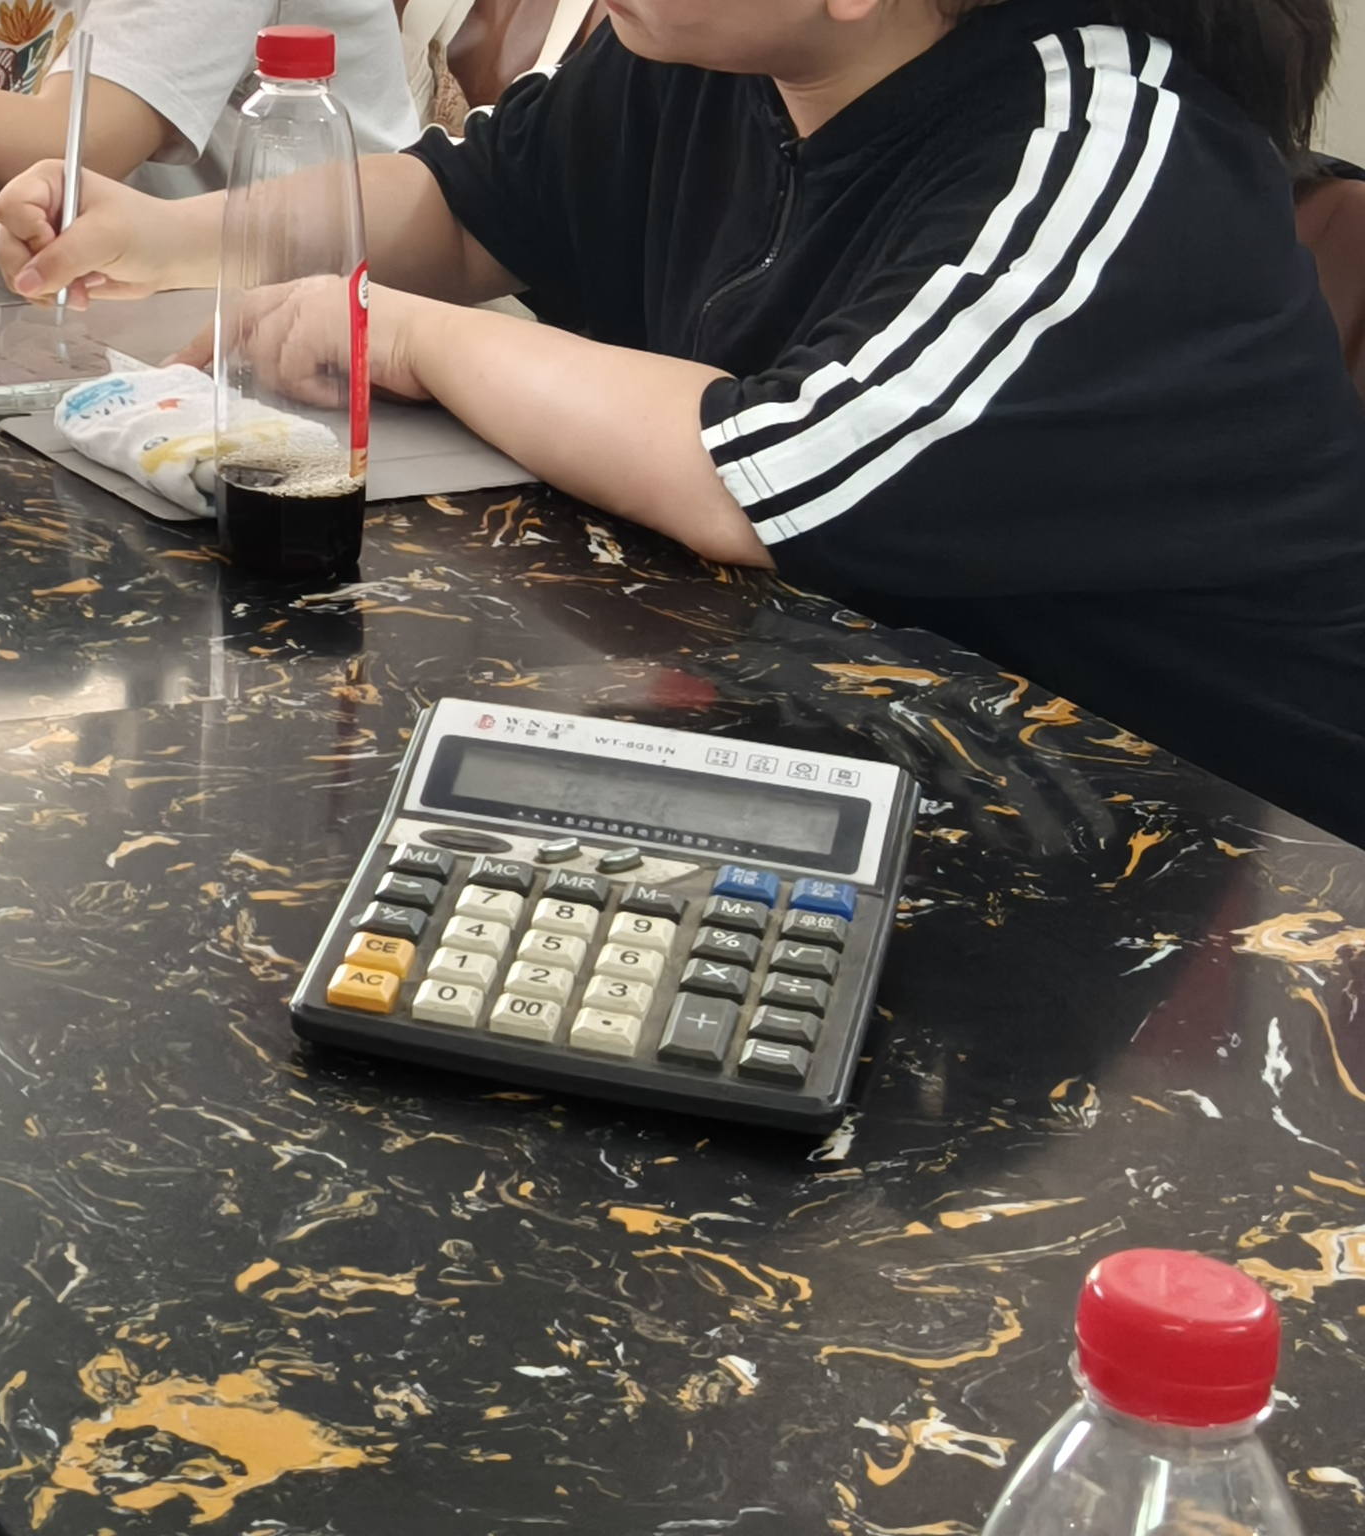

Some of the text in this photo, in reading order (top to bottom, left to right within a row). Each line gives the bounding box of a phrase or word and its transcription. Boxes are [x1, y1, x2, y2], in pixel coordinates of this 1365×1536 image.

[403, 848, 440, 864] MU
[483, 860, 519, 876] MC
[558, 873, 596, 889] MR
[480, 890, 501, 904] 7
[555, 905, 575, 919] 8
[465, 923, 488, 937] 4
[632, 919, 652, 933] 9
[365, 938, 400, 954] CE
[541, 936, 563, 951] 5
[712, 931, 740, 947] %
[455, 955, 468, 968] 1
[619, 950, 641, 965] 6
[348, 972, 384, 986] AC
[528, 968, 551, 984] 2
[437, 985, 459, 1001] 0
[607, 982, 628, 997] 3
[509, 998, 543, 1016] 00
